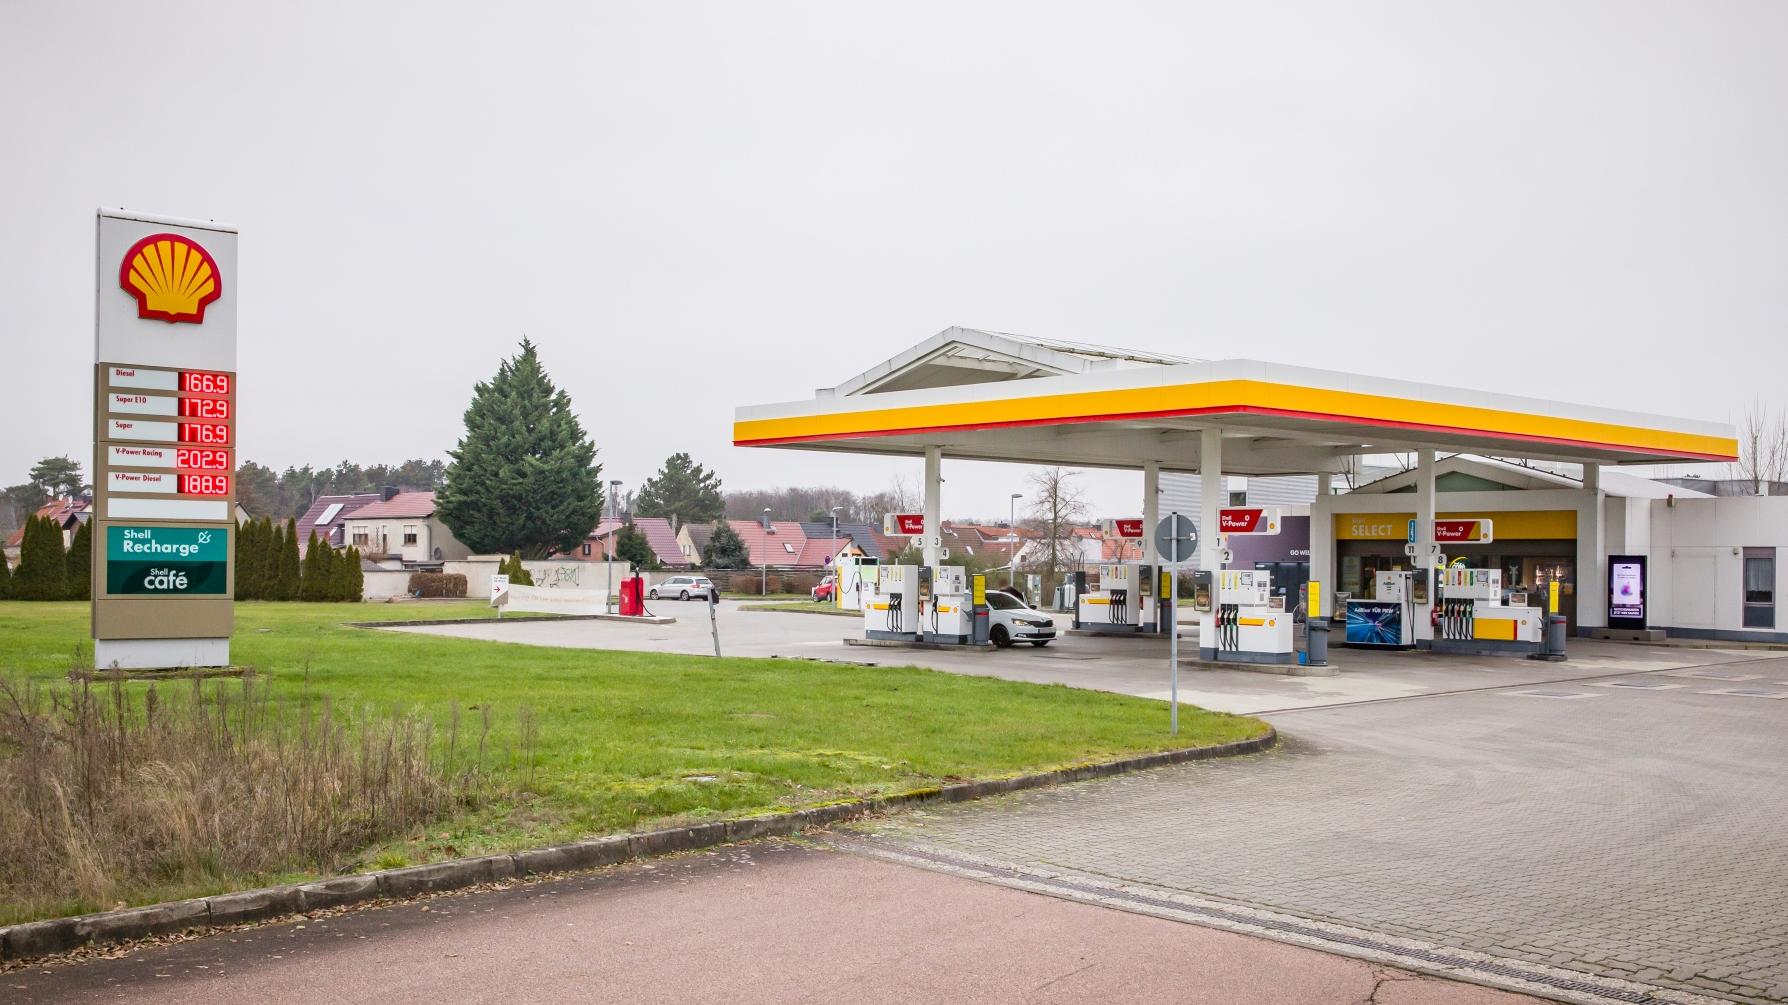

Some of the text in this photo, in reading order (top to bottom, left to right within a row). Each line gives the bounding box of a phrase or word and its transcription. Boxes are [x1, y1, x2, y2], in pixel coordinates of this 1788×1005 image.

[185, 374, 228, 393] 166.9
[185, 399, 227, 418] 172.9
[185, 424, 226, 443] 176.9
[142, 448, 162, 457] Racing
[178, 450, 226, 469] 202.9
[184, 475, 226, 494] 188.9
[124, 530, 151, 539] Shell
[1352, 525, 1392, 536] SELECT
[123, 540, 199, 556] Recharge
[1224, 552, 1229, 560] 2
[144, 571, 187, 589] café
